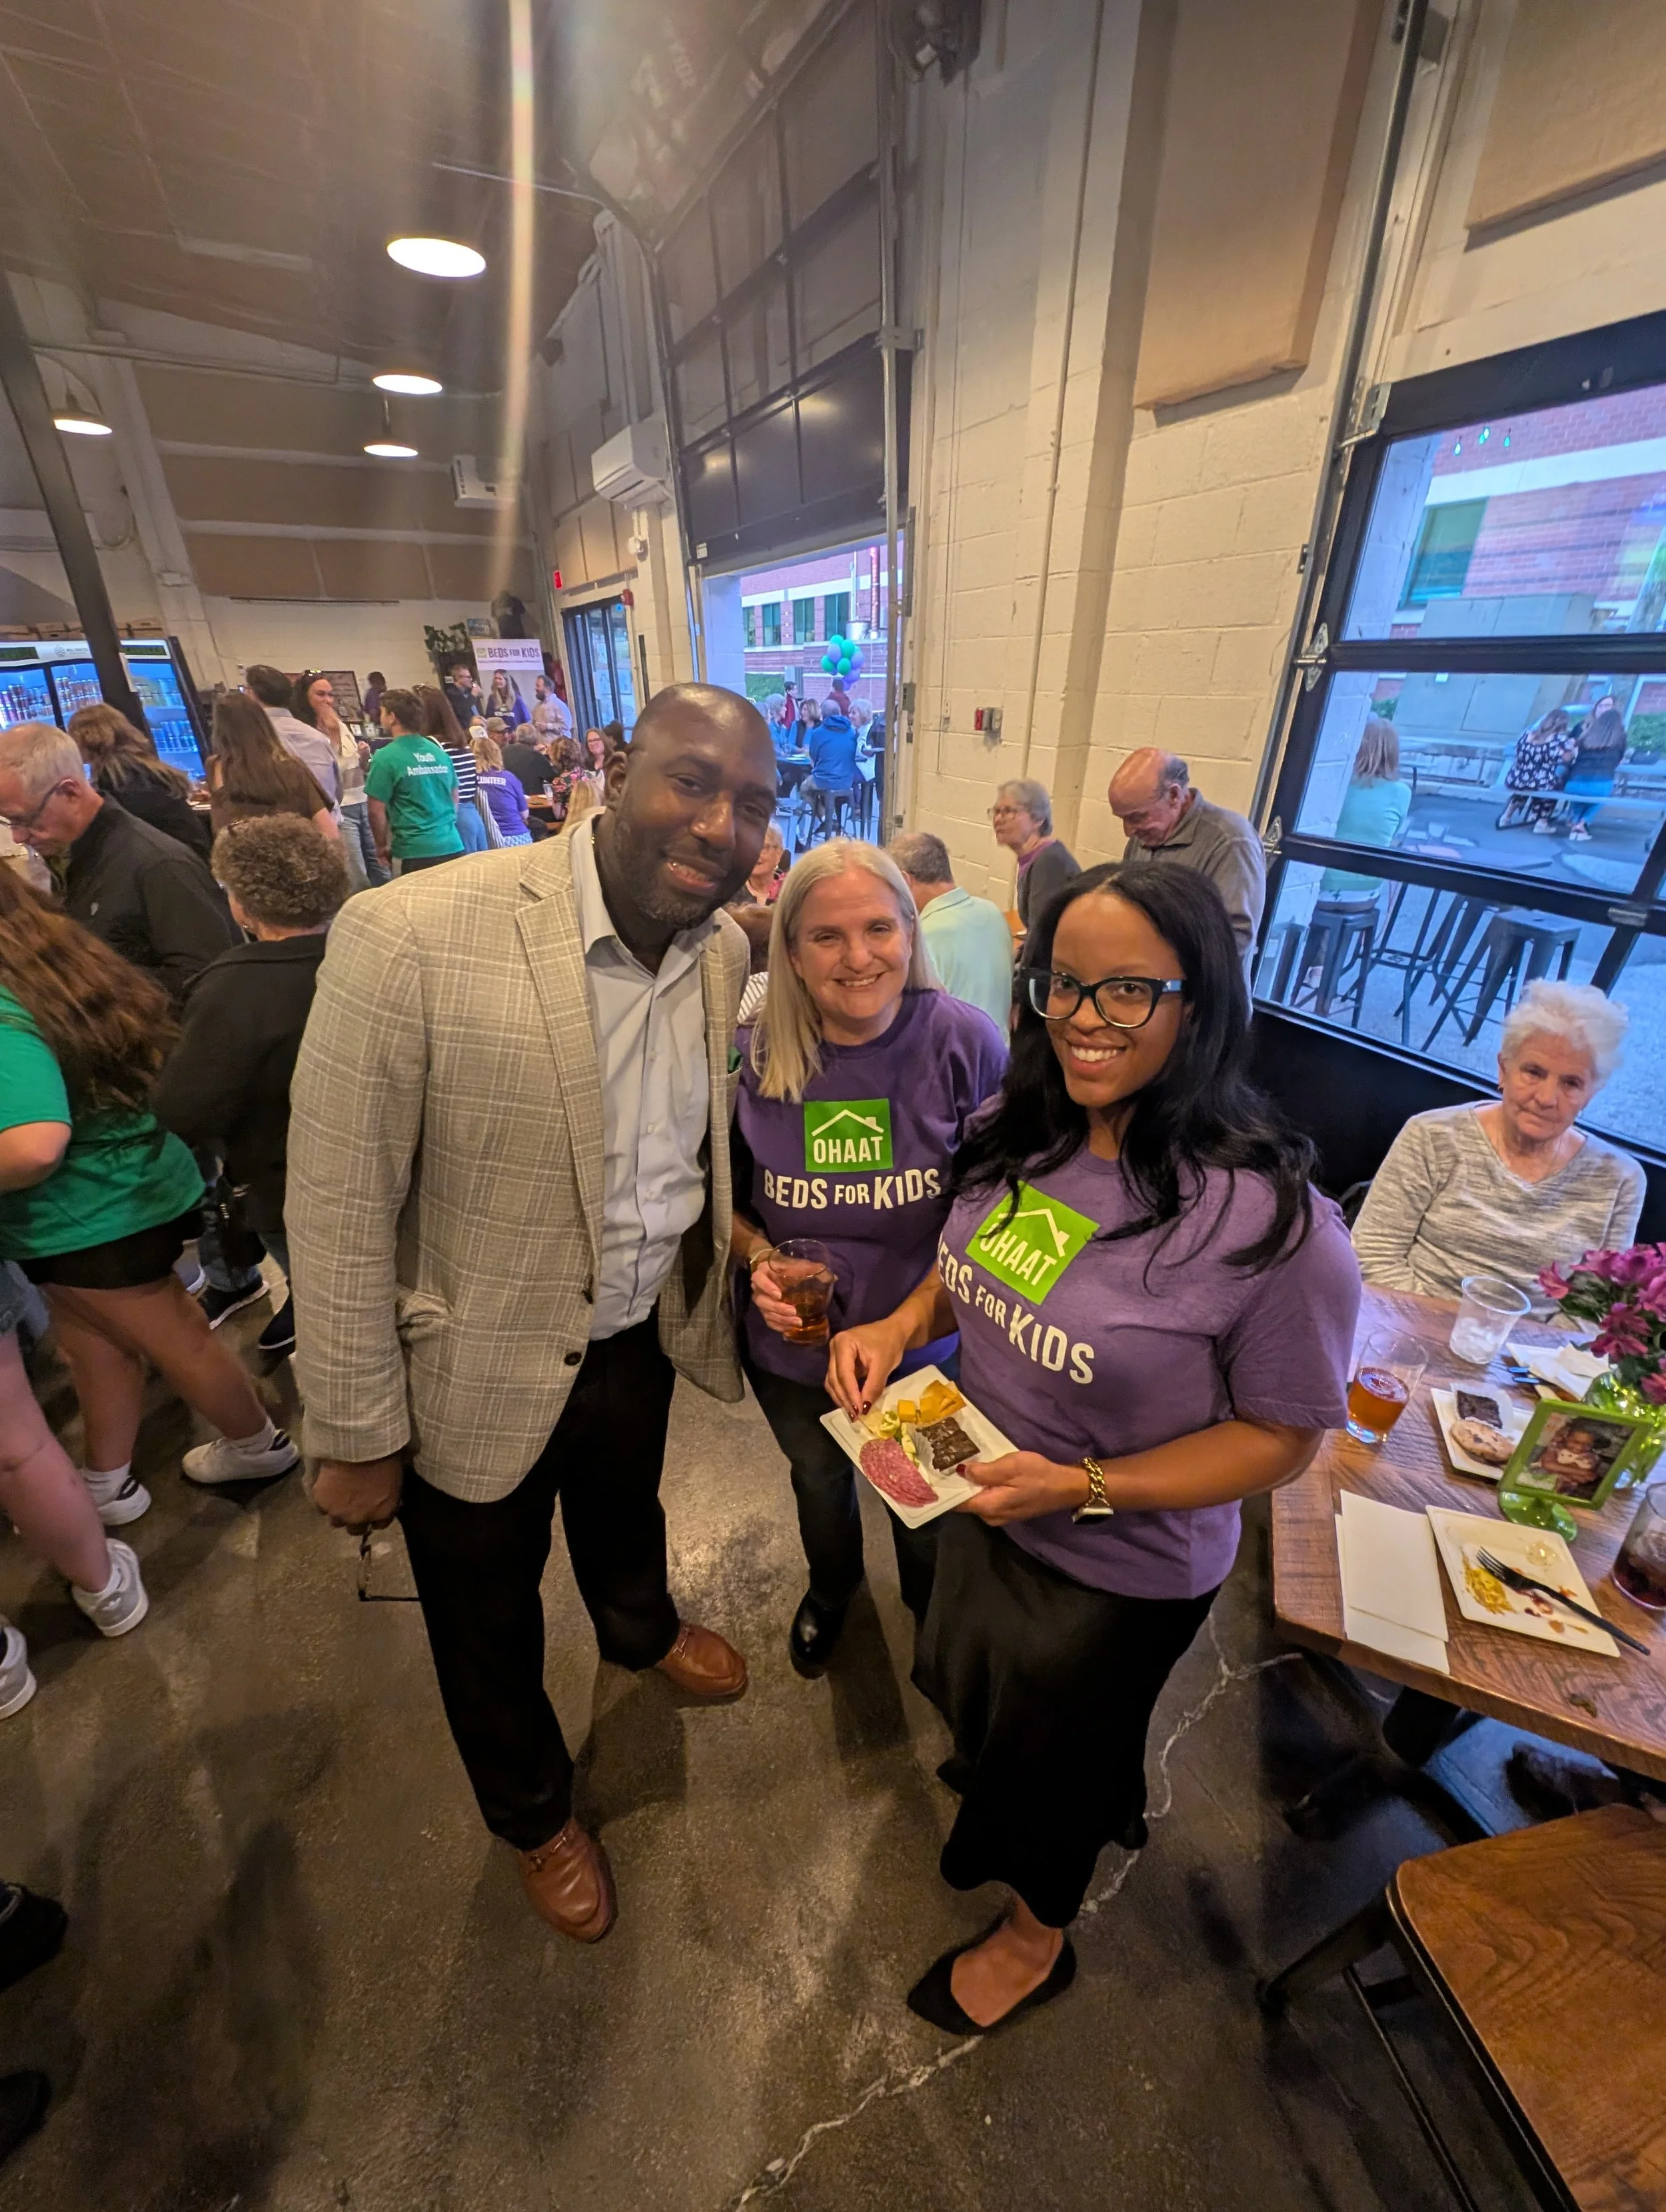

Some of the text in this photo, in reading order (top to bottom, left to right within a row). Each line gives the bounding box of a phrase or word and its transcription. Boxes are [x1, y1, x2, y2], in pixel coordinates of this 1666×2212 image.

[487, 647, 508, 658] BEDS
[520, 647, 540, 658] KIDS
[413, 752, 436, 762] Youth
[407, 764, 448, 777] Ambassador
[476, 776, 506, 786] LUNTEER
[813, 1136, 884, 1163] OHAAT
[764, 1168, 942, 1210] BEDS FOR KIDS
[938, 1231, 1095, 1384] EDS FOR KIDS
